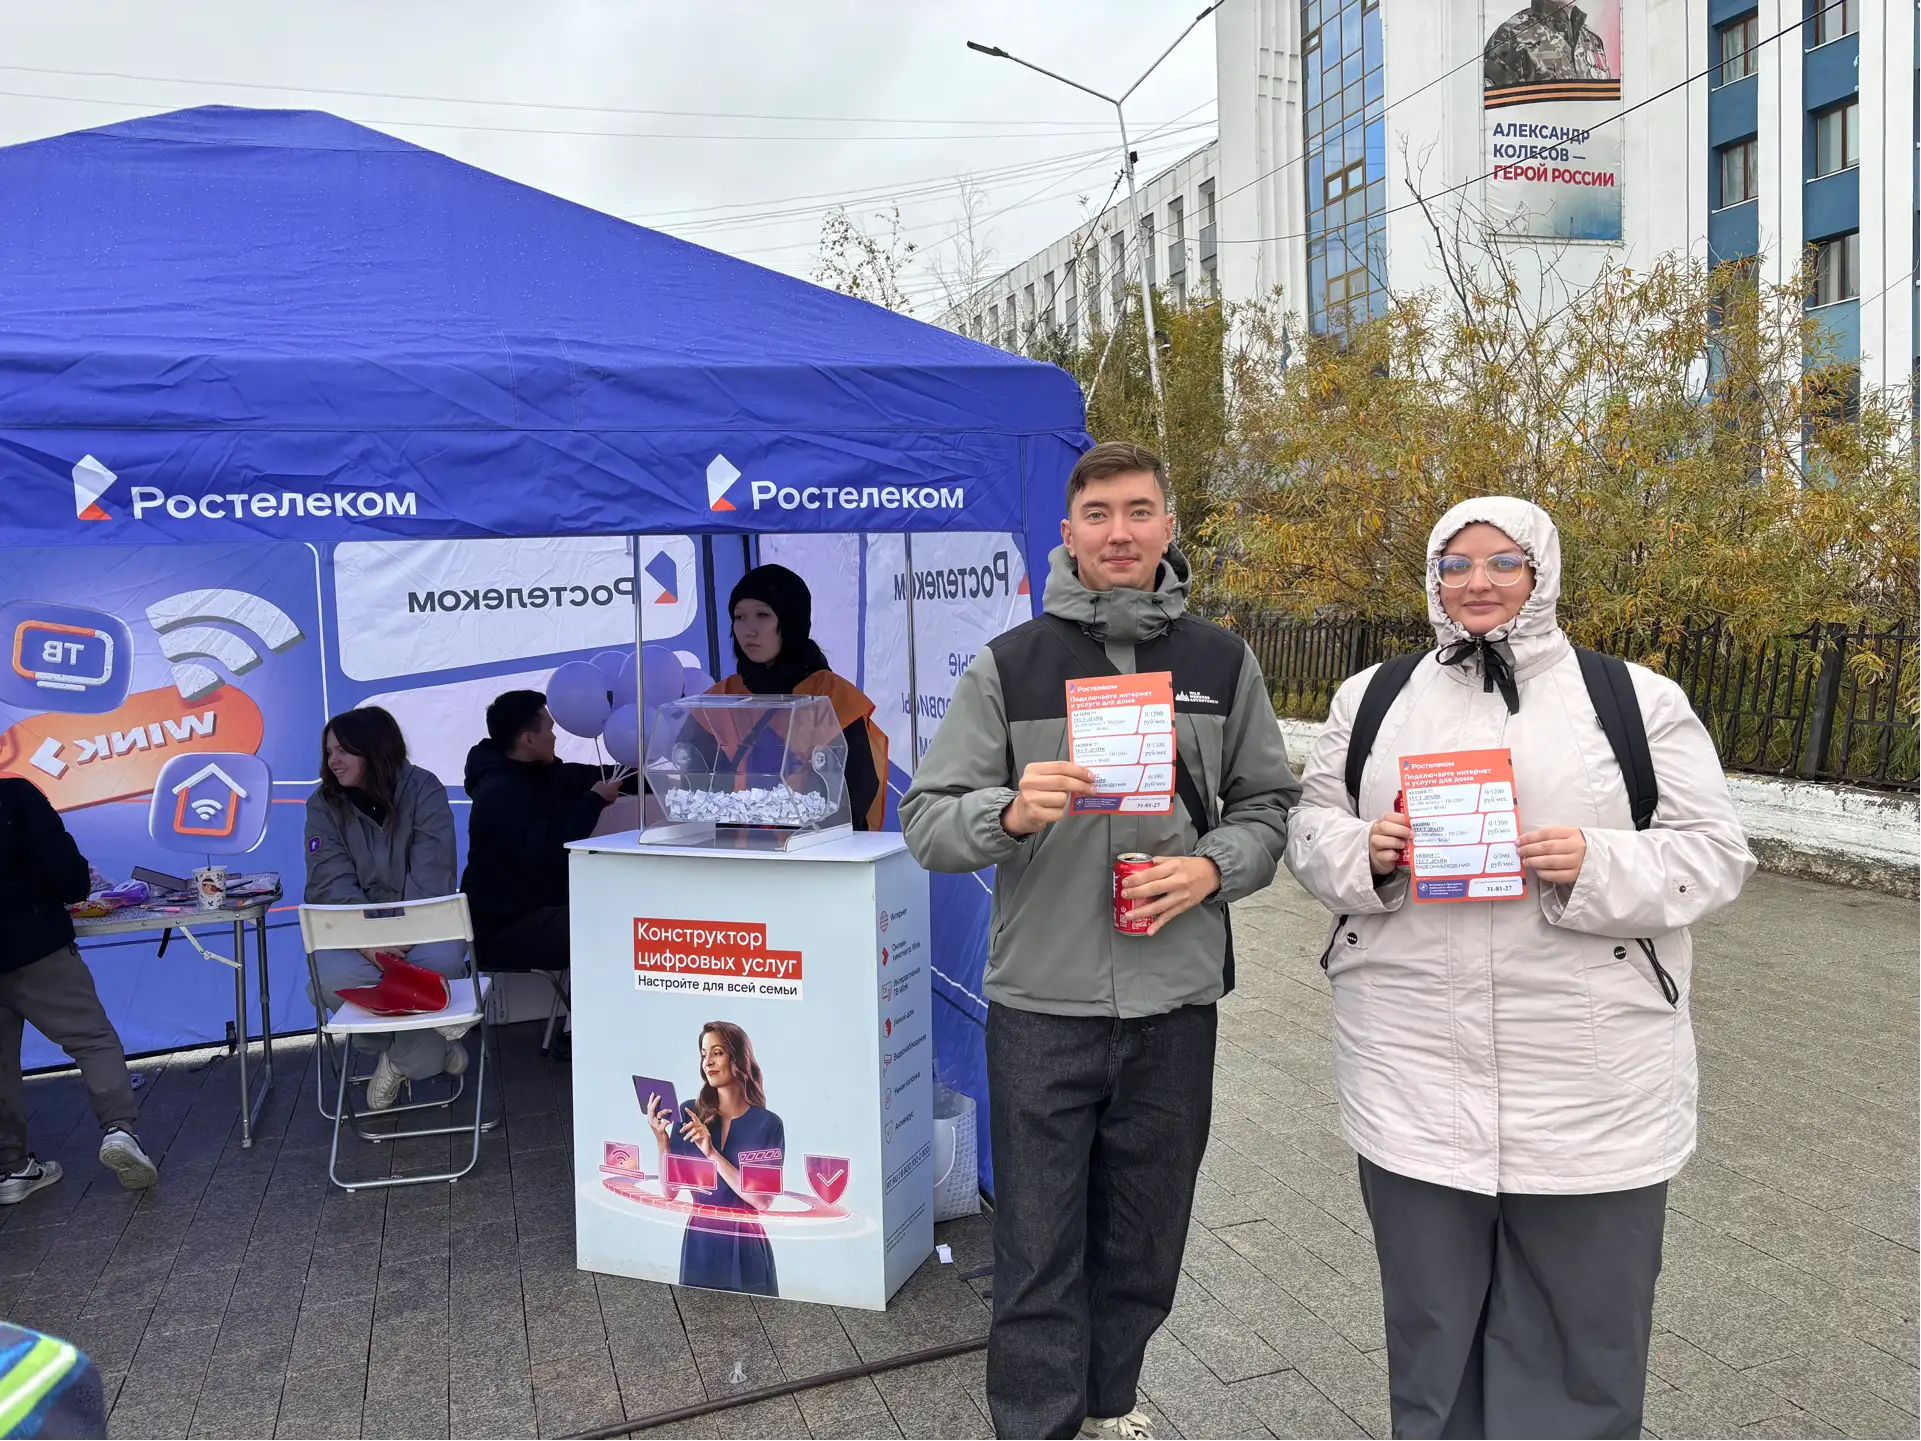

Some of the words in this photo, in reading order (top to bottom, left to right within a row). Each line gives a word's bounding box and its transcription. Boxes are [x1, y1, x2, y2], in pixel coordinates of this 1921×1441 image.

[1493, 122, 1590, 145] АЛЕКСАНДР
[1493, 143, 1569, 161] КОЛЕСОВ
[1493, 163, 1548, 182] ГЕРОЙ
[1552, 167, 1615, 187] РОССИИ
[131, 486, 417, 520] Ростелеком
[751, 480, 963, 511] Ростелеком
[1486, 885, 1512, 893] 31-81-27
[637, 921, 763, 950] Конструктор
[638, 949, 736, 972] цифровых
[741, 956, 797, 977] услуг
[638, 974, 699, 990] Настройте
[702, 982, 724, 992] для
[727, 982, 756, 993] всей
[759, 985, 798, 996] семьи
[894, 1110, 915, 1131] Антивирус
